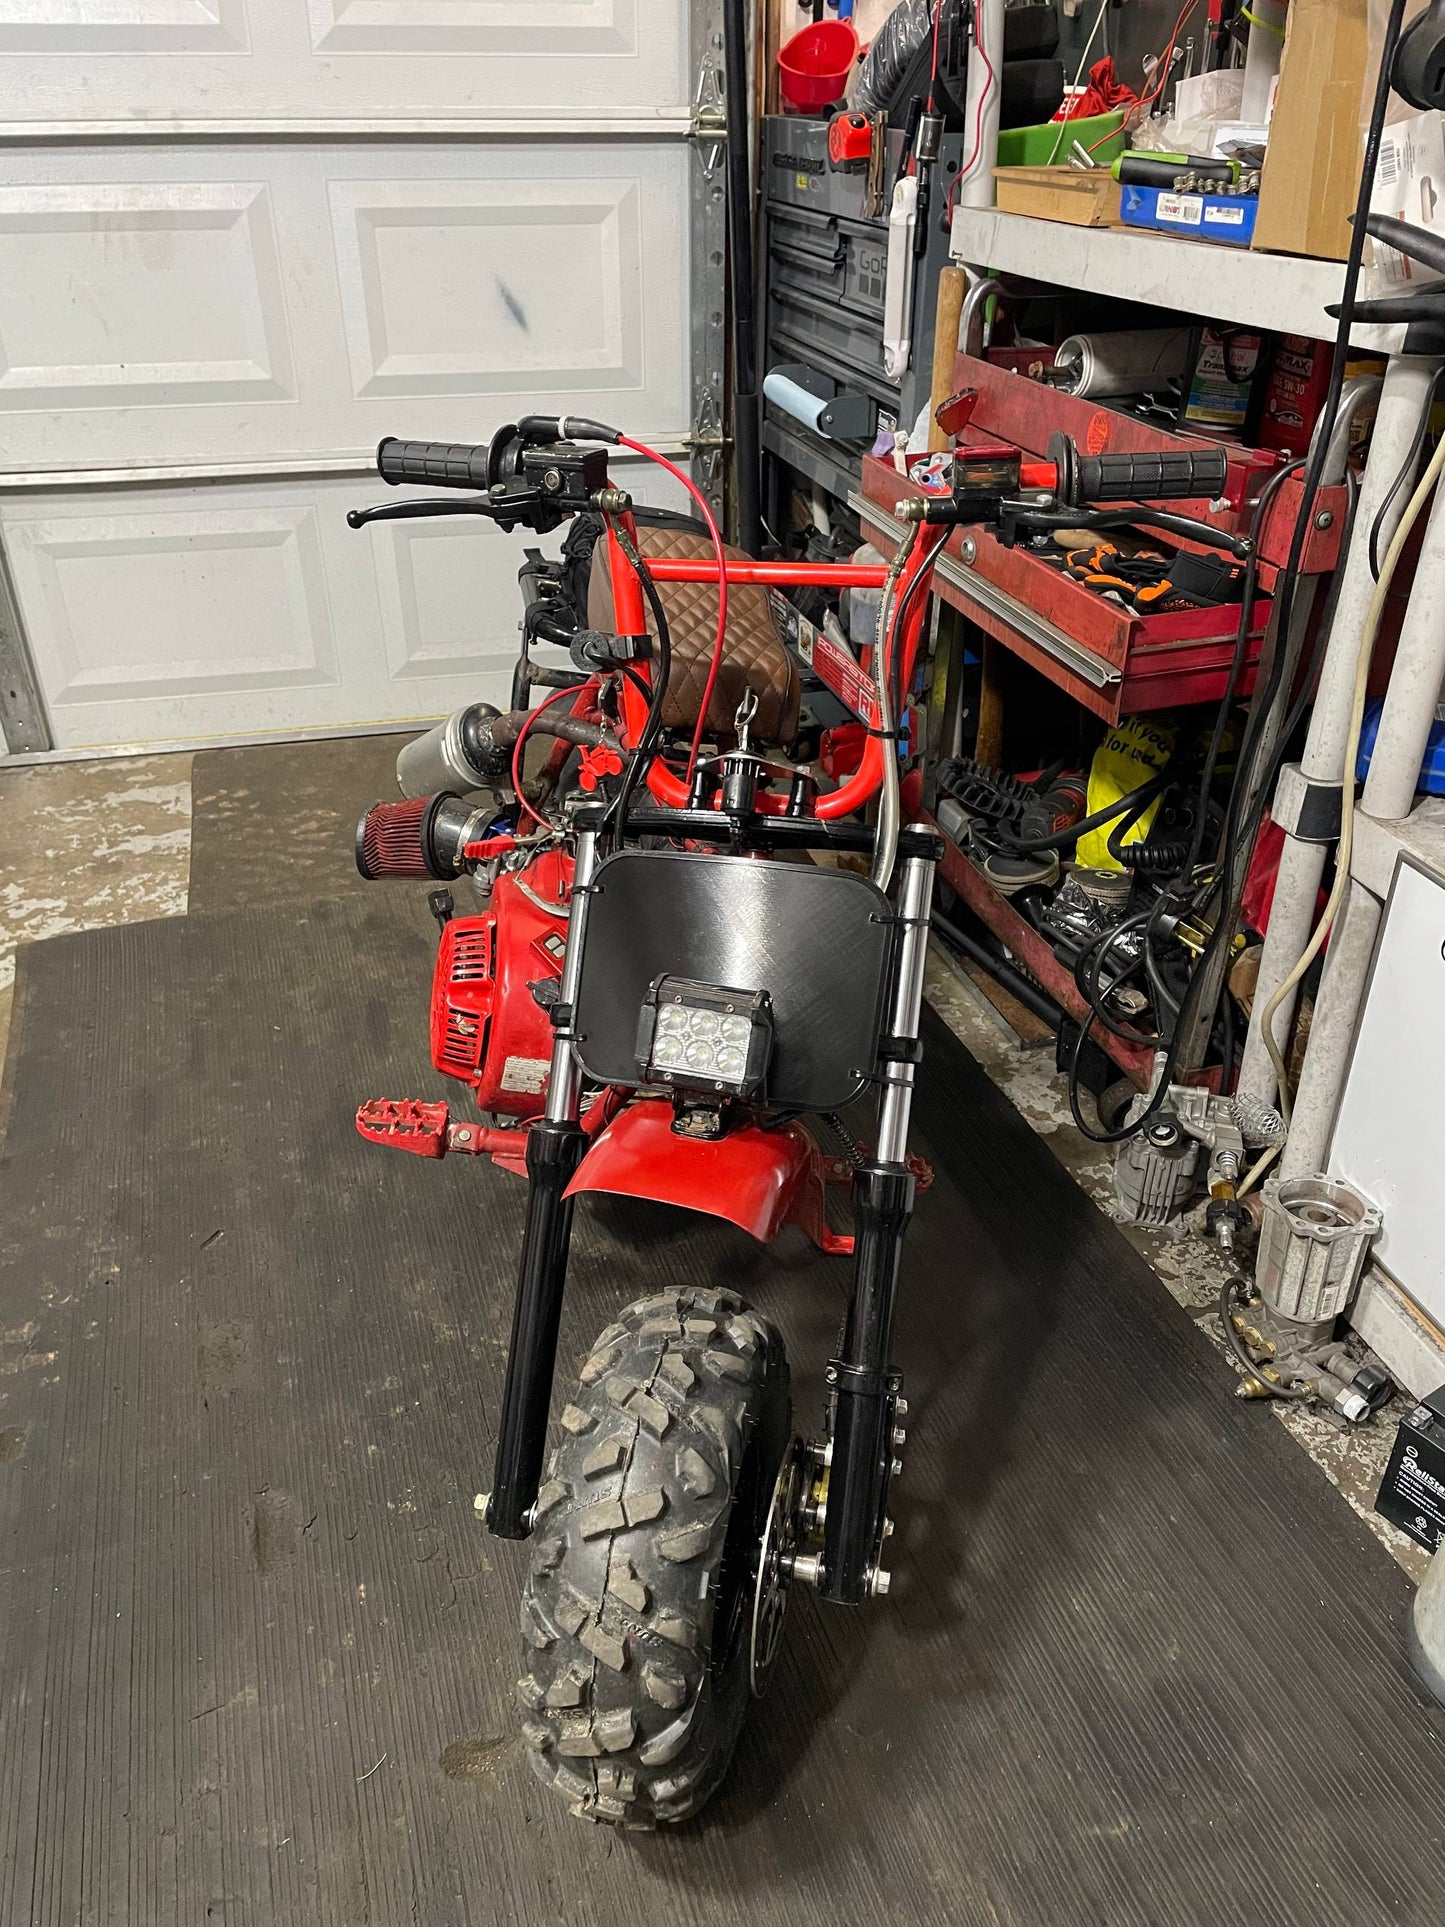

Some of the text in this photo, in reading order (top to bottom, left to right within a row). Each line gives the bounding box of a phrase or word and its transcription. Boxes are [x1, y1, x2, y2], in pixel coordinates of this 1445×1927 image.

[859, 250, 888, 276] GoP
[1203, 360, 1249, 373] Tranax
[1105, 734, 1130, 754] for
